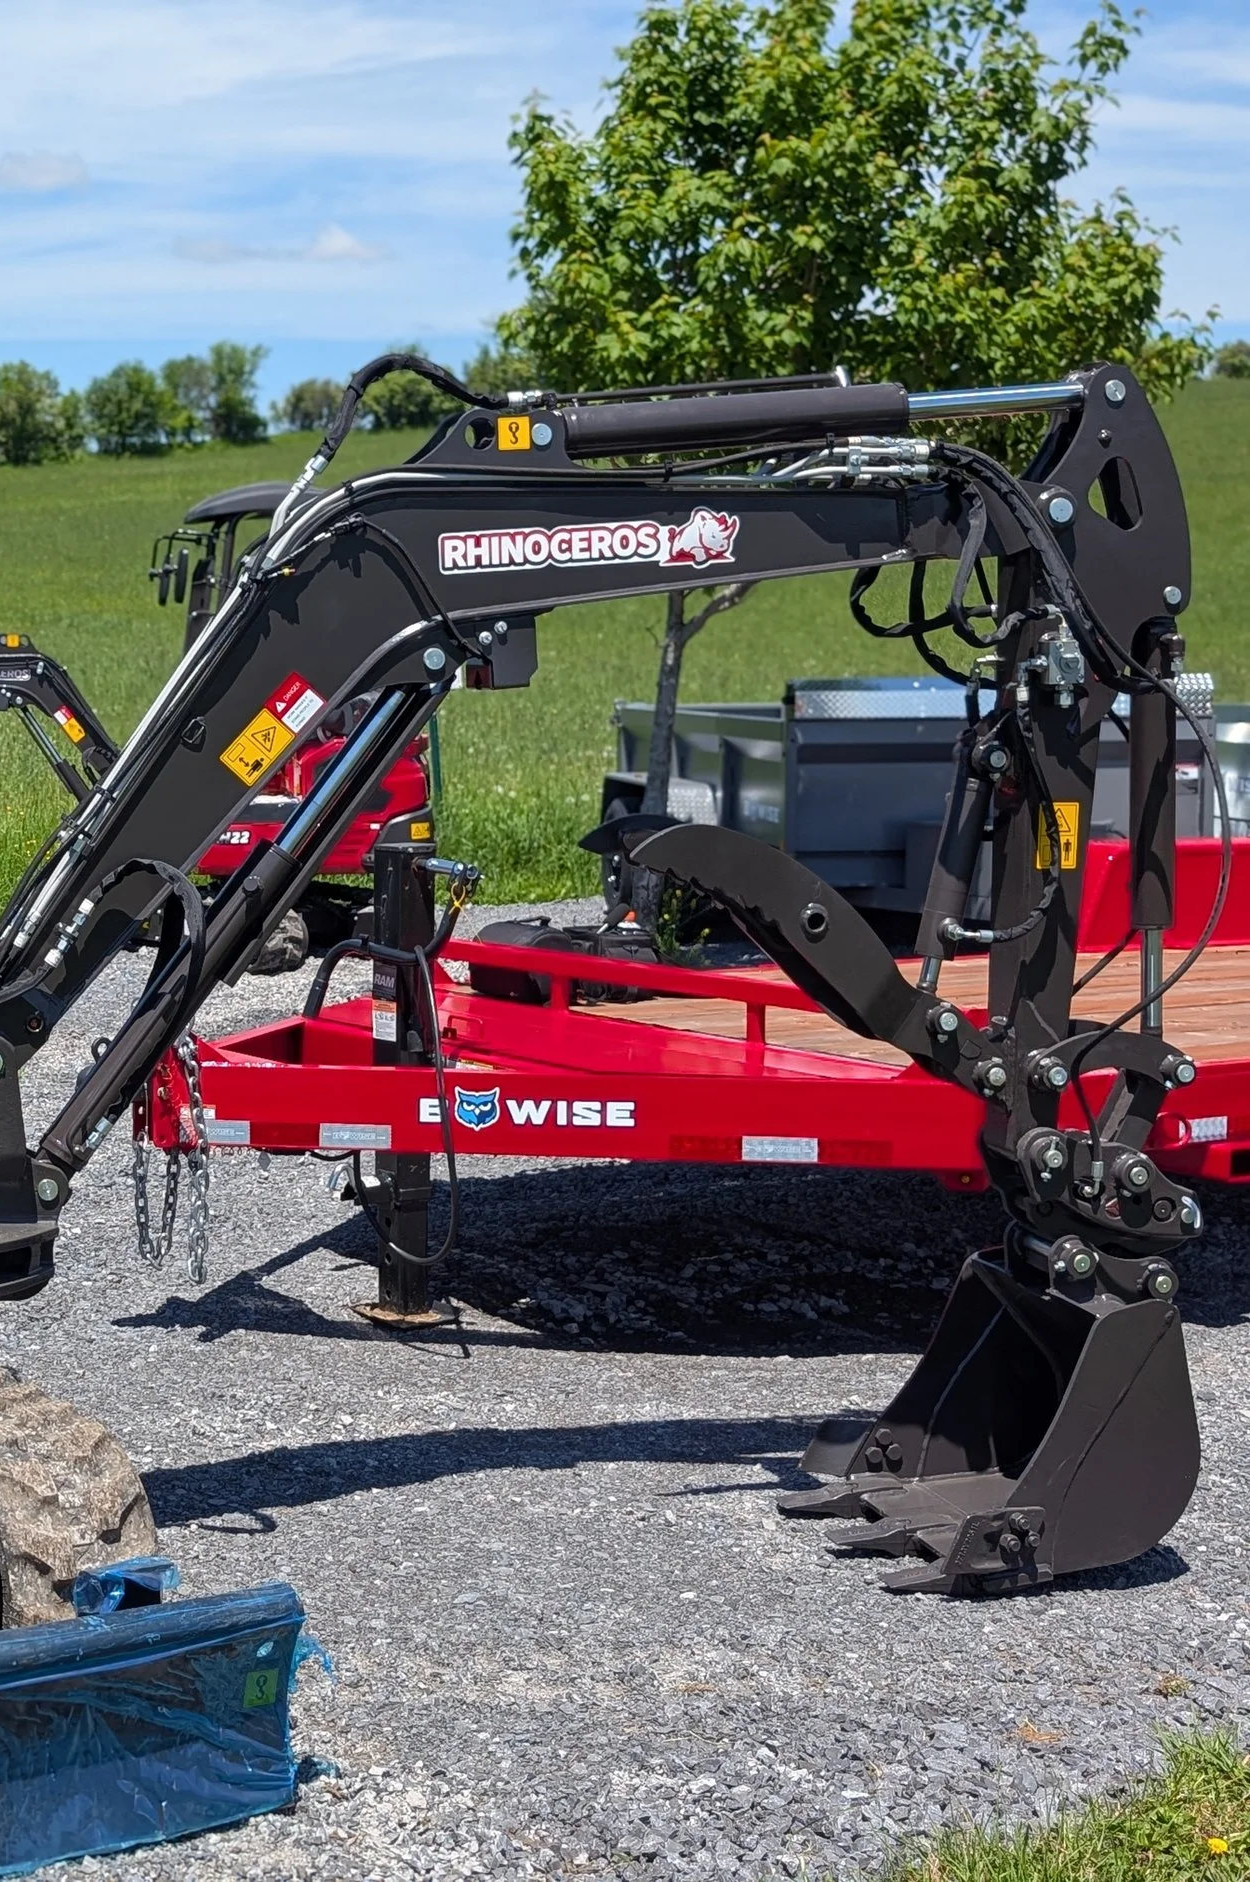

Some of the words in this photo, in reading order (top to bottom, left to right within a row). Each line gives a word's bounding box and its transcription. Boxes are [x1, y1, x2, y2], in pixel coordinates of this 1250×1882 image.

[443, 524, 659, 569] RHINOCEROS
[216, 830, 251, 844] H22
[374, 973, 395, 989] RAM
